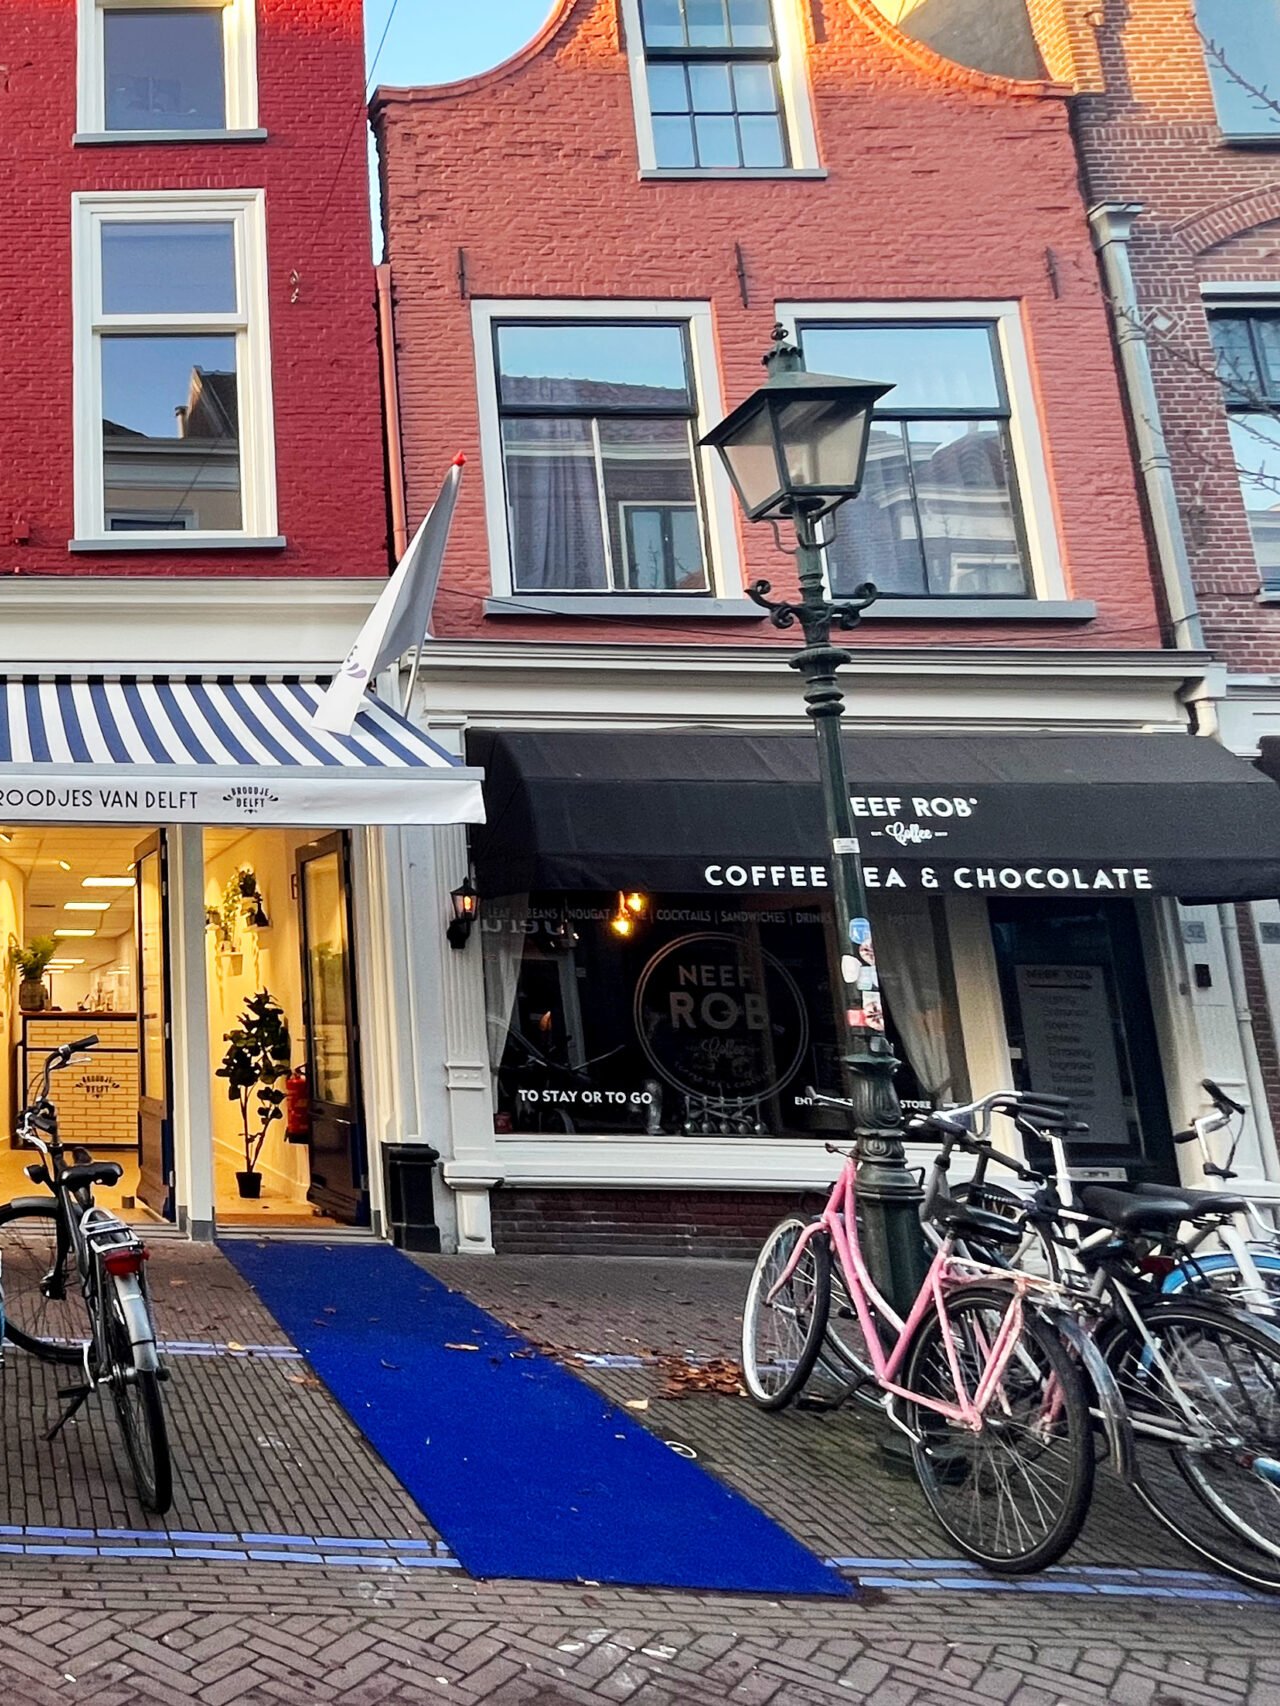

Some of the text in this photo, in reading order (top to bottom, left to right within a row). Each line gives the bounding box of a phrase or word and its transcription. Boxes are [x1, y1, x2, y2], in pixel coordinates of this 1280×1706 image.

[99, 790, 138, 808] VAN
[146, 791, 198, 809] DELFT
[231, 786, 269, 797] BROODJE
[236, 797, 265, 808] DELFT
[850, 797, 901, 816] EEF
[885, 821, 933, 846] Coffee
[705, 865, 1152, 889] COFFEE EA & CHOCOLATE
[527, 908, 558, 919] BEANS
[569, 908, 611, 920] NOUGAT
[657, 909, 711, 922] COCKTAILS
[721, 910, 786, 924] SANDWICHES
[679, 965, 754, 987] NEEF
[670, 992, 770, 1030] ROB
[519, 1089, 652, 1104] TO STAY OR TO GO
[900, 1100, 931, 1109] STORE
